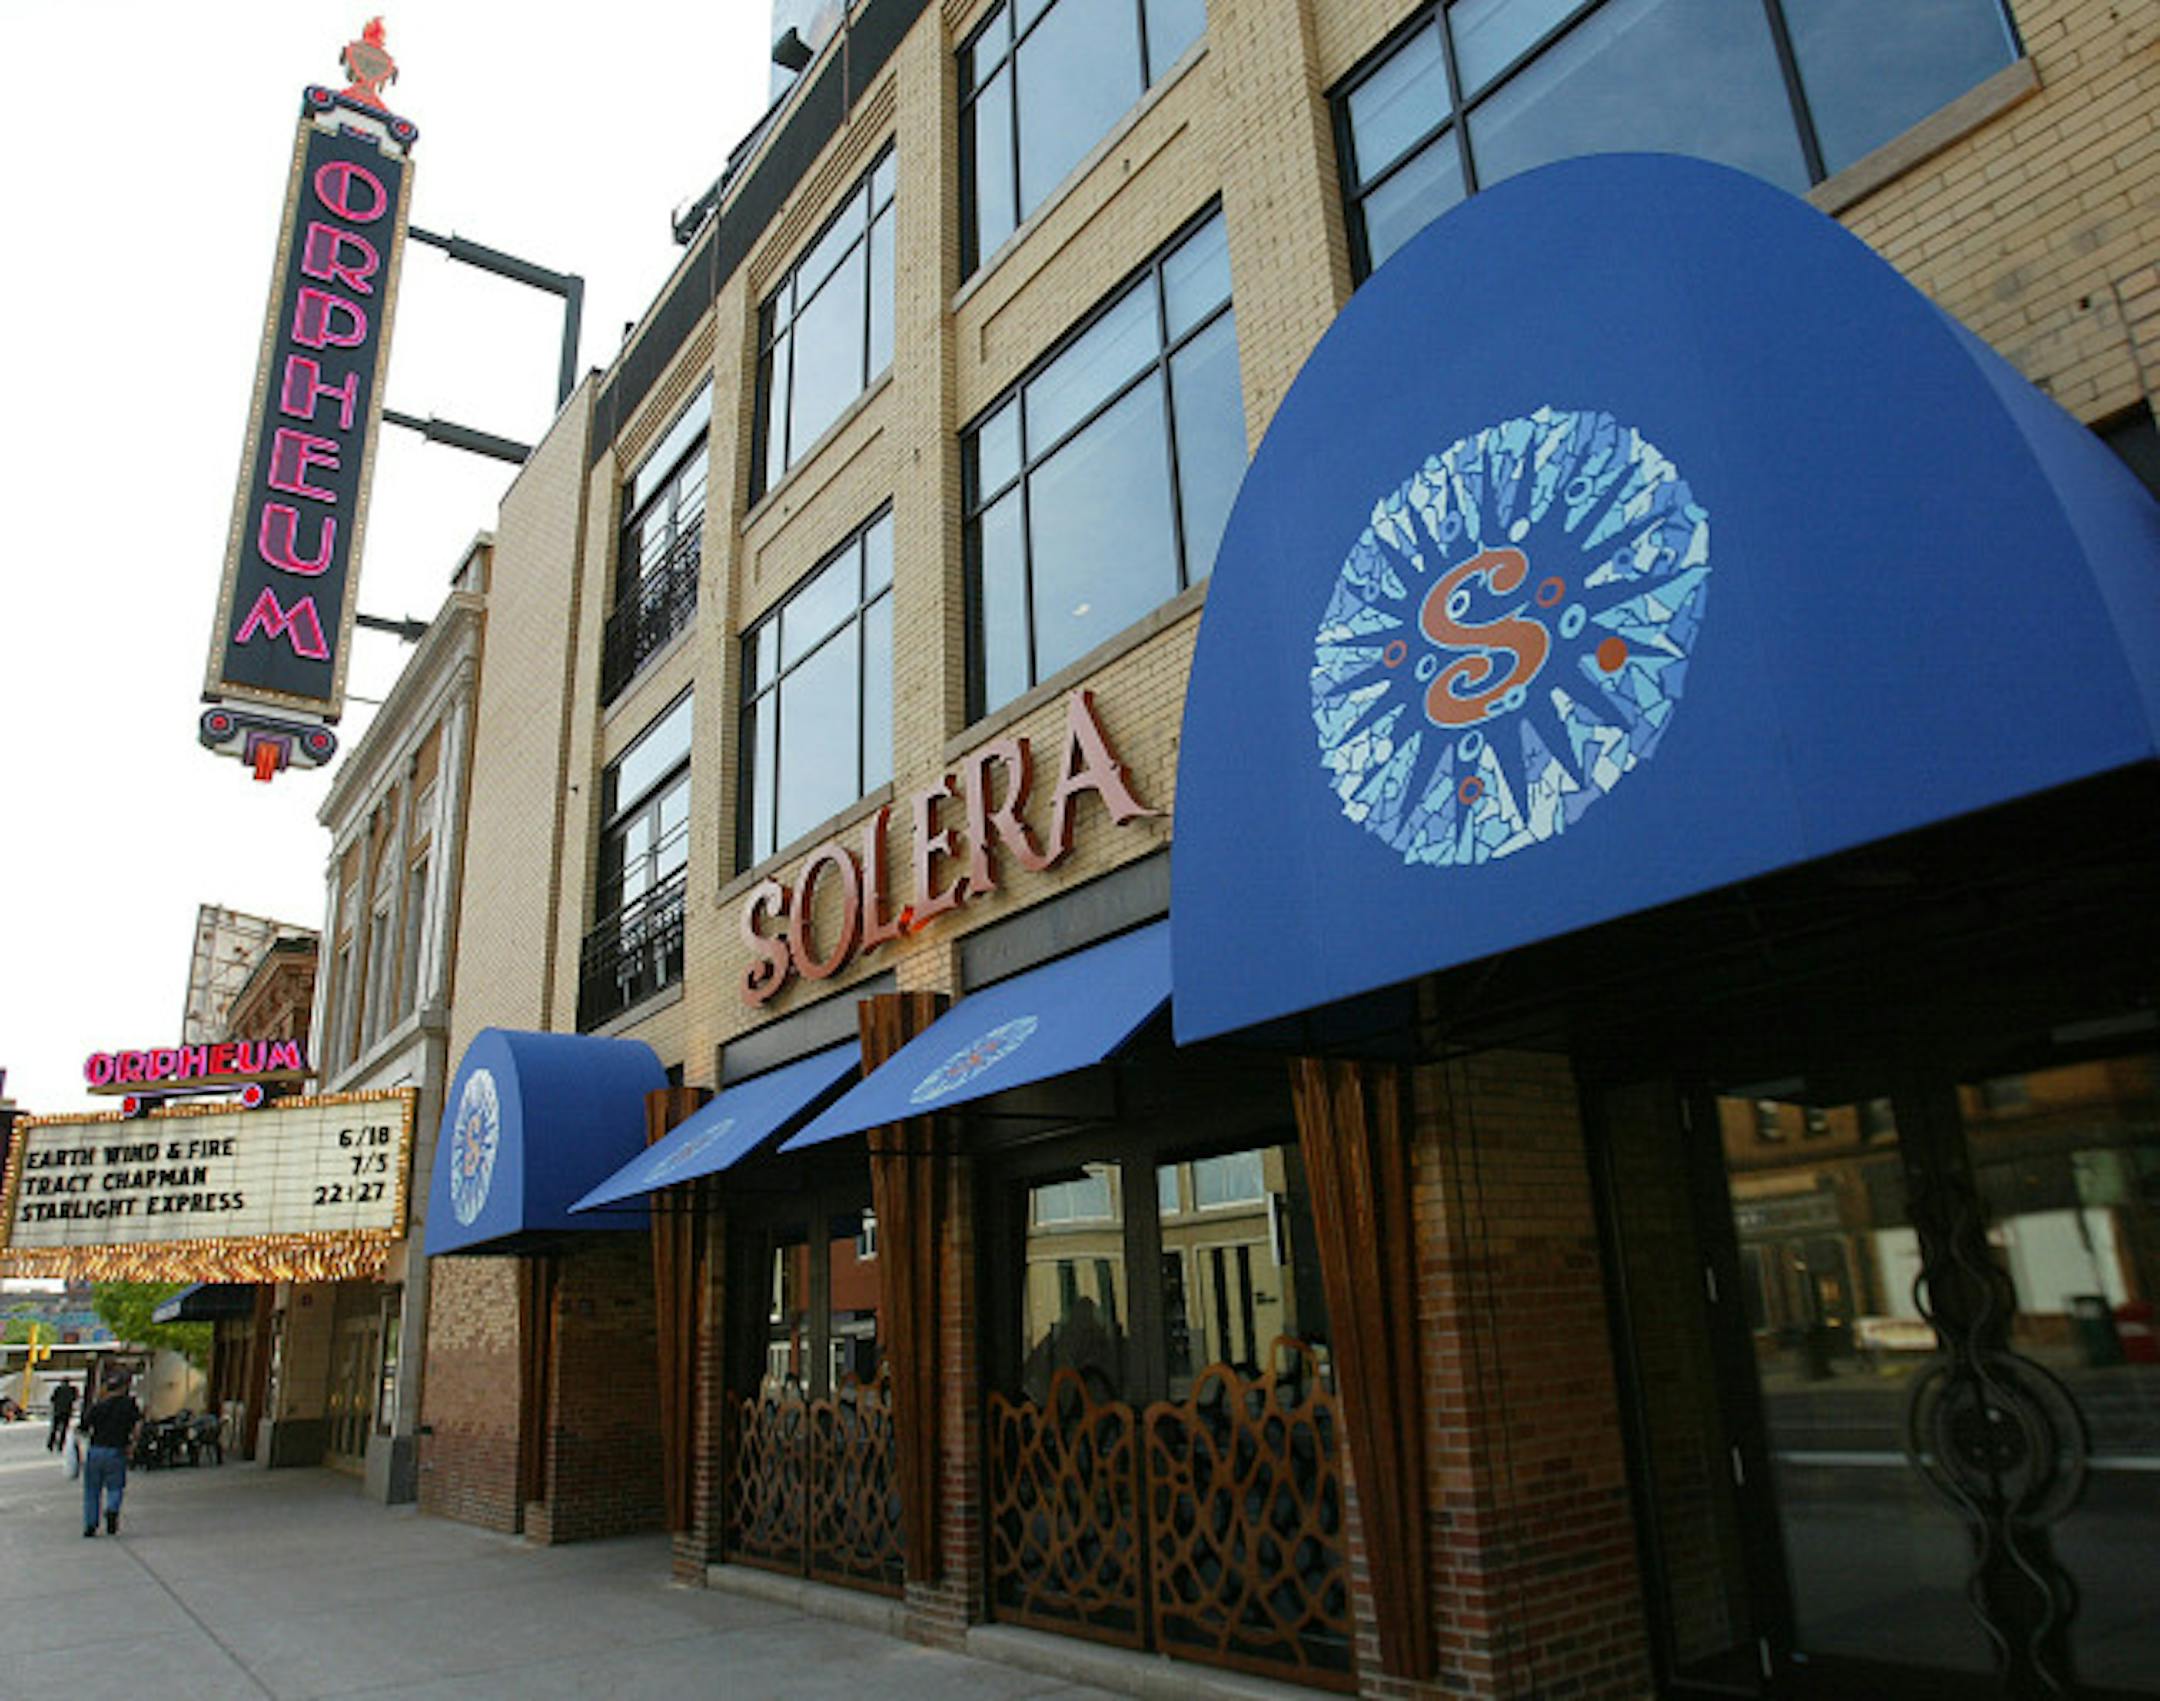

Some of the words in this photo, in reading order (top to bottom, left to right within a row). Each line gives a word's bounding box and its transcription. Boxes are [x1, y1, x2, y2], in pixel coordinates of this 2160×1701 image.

[236, 160, 390, 661] ORPHEUM
[741, 688, 1170, 1008] SOLERA
[83, 1038, 301, 1086] ORPHEUM
[339, 1126, 390, 1148] 6/18
[27, 1148, 94, 1169] EARTH
[104, 1143, 160, 1165] WIND
[167, 1142, 180, 1159] &
[188, 1138, 236, 1159] FIRE
[351, 1152, 388, 1176] 7/5
[25, 1174, 93, 1195] TRACY
[102, 1166, 208, 1191] CHAPMAN
[20, 1198, 137, 1222] STARLIGHT
[147, 1192, 244, 1216] EXPRESS
